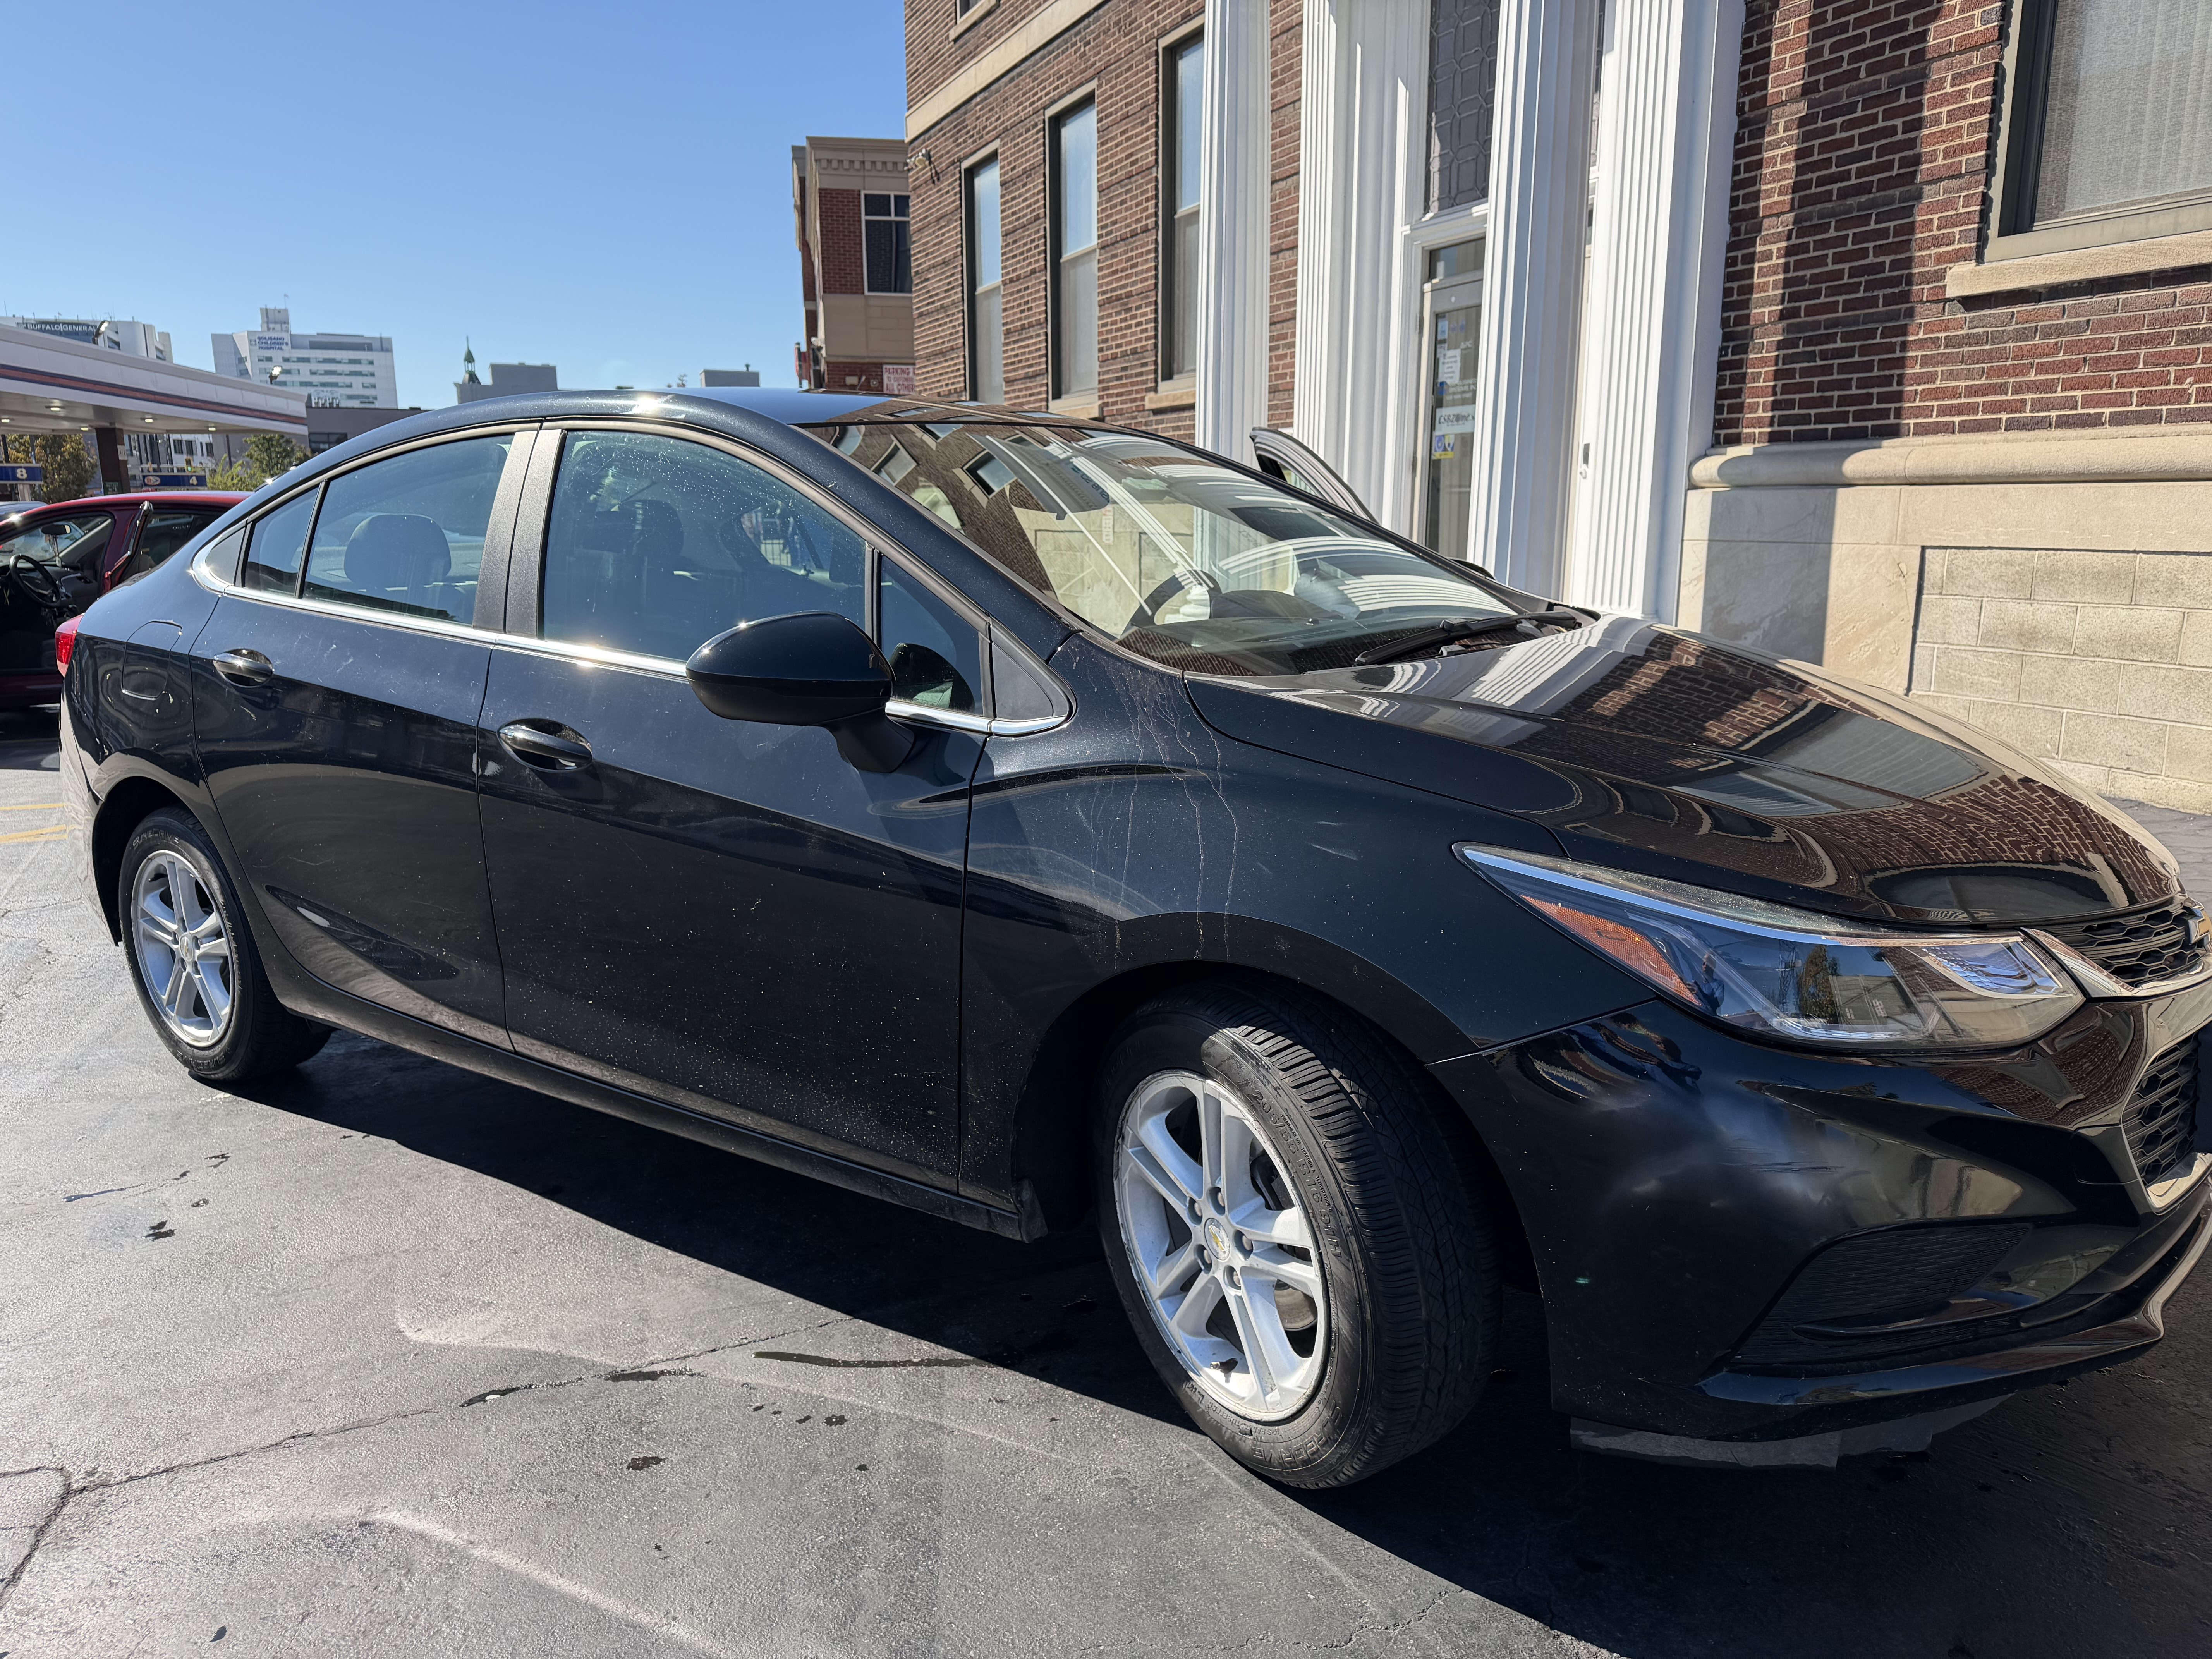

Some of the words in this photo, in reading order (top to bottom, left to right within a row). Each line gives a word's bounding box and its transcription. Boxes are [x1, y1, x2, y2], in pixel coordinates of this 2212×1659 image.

[17, 468, 27, 479] 8
[189, 476, 198, 486] 4
[1252, 1089, 1299, 1154] 205/55
[1297, 1158, 1323, 1203] R16
[1319, 1209, 1342, 1258] 91H
